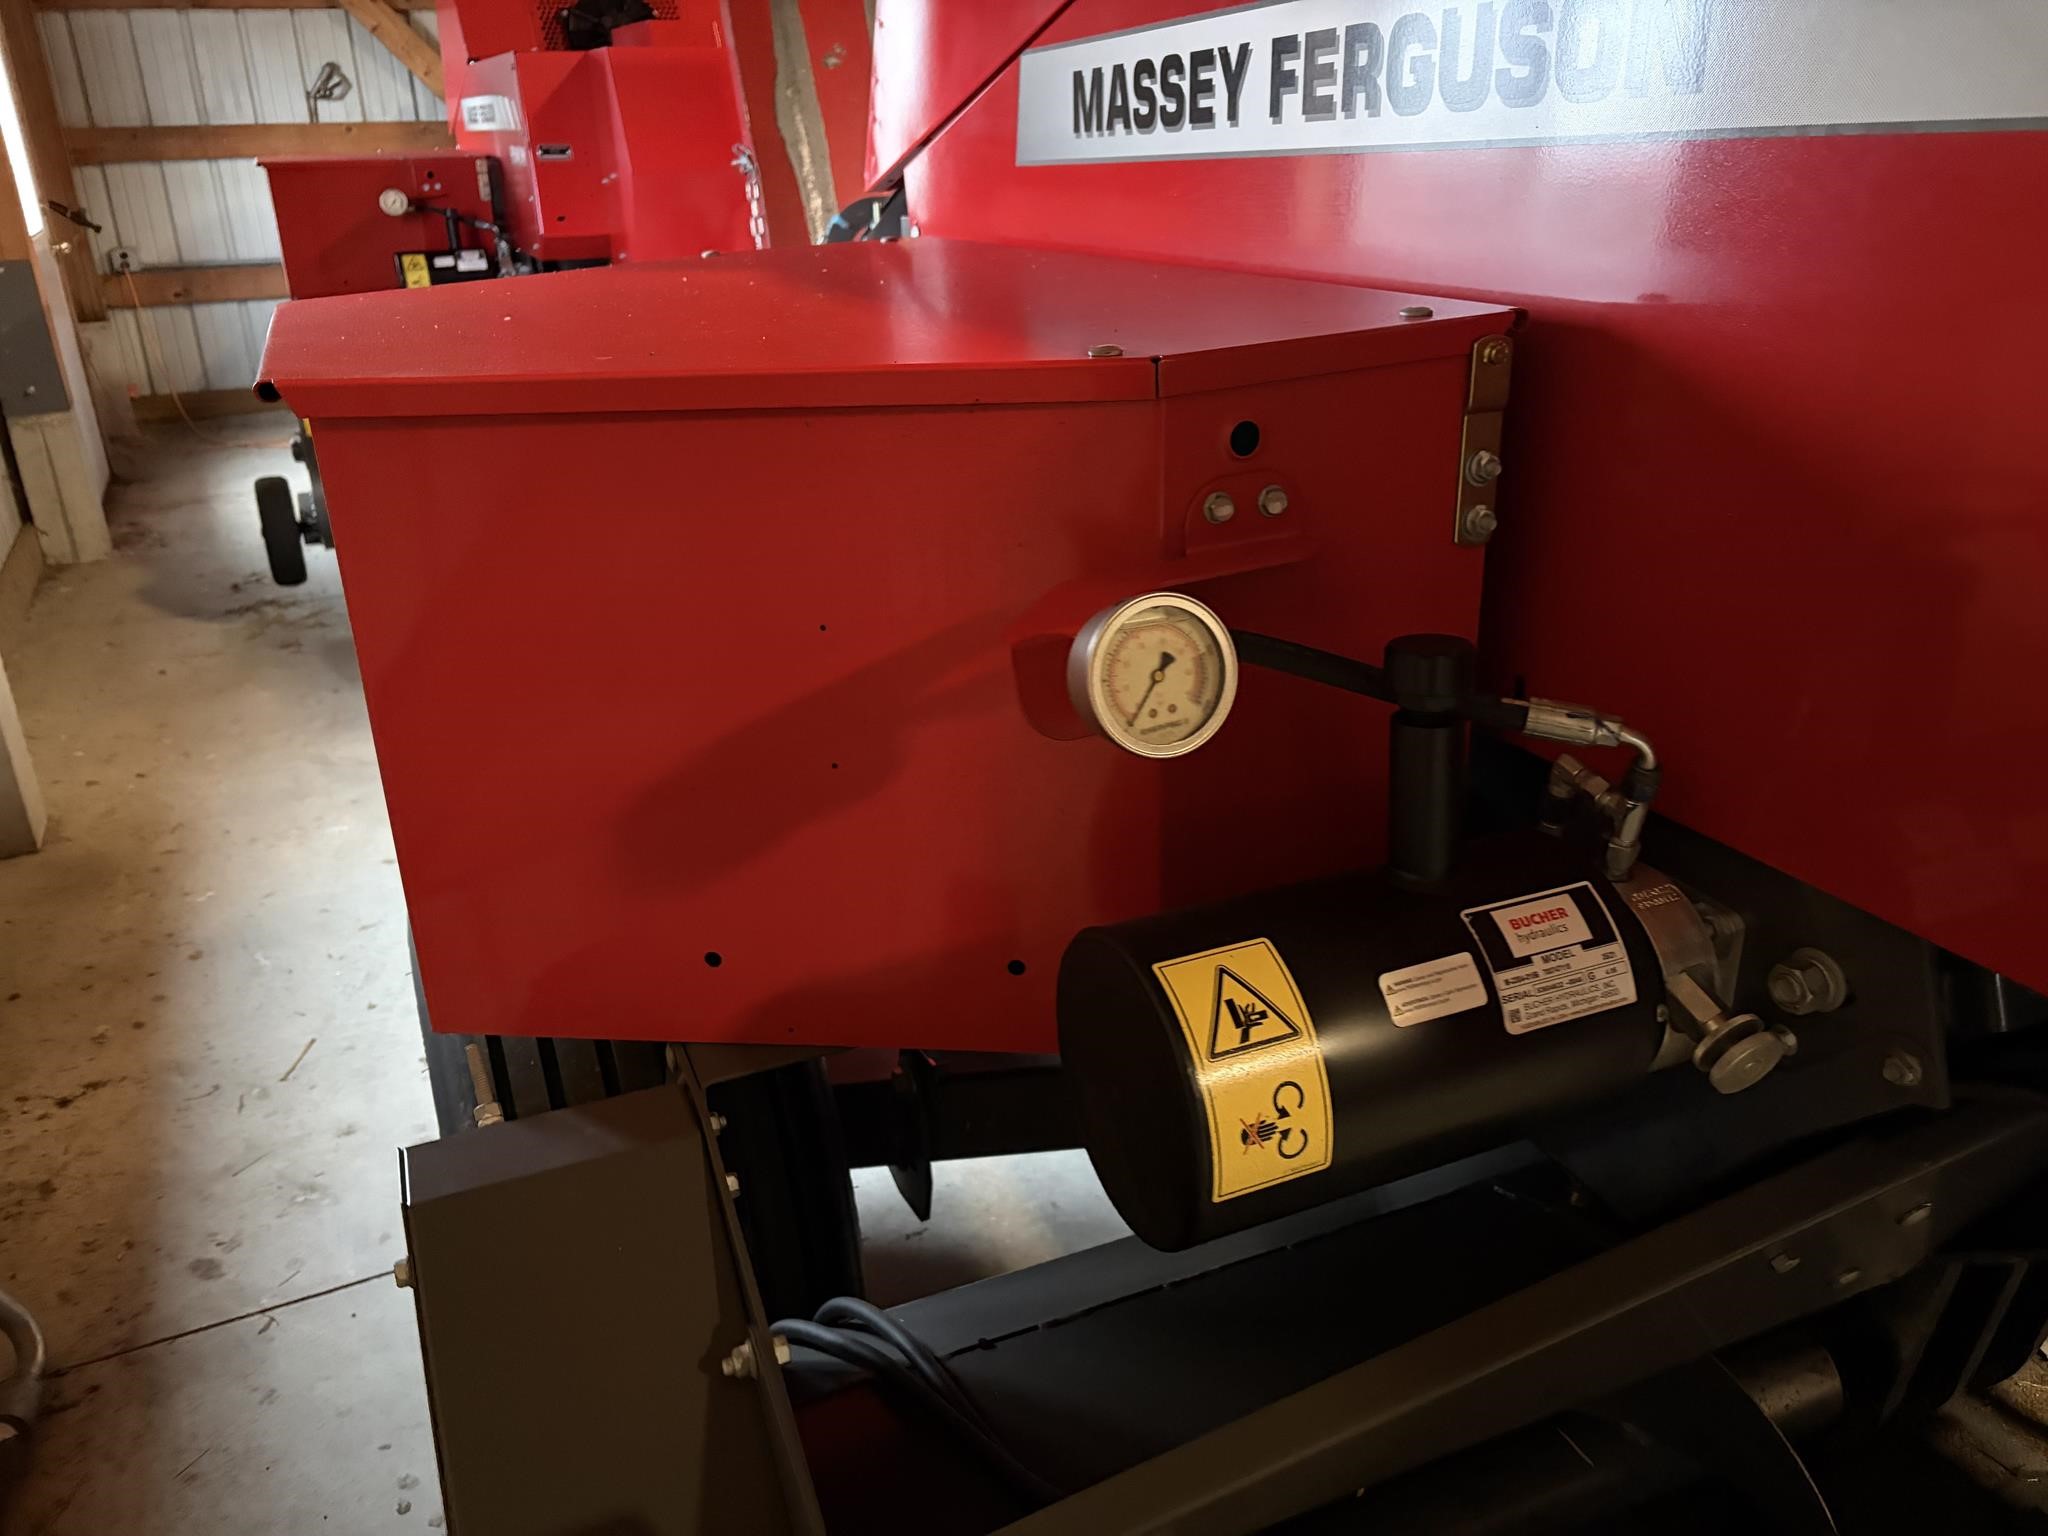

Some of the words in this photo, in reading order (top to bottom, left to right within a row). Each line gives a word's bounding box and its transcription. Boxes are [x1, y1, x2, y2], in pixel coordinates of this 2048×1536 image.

[1072, 42, 1253, 137] MASSEY
[1269, 0, 1704, 121] FERGUSON
[1508, 907, 1569, 930] BUCHER
[1516, 923, 1569, 944] hydraulics
[1540, 950, 1576, 964] MODEL
[1501, 989, 1534, 1004] SERIAL
